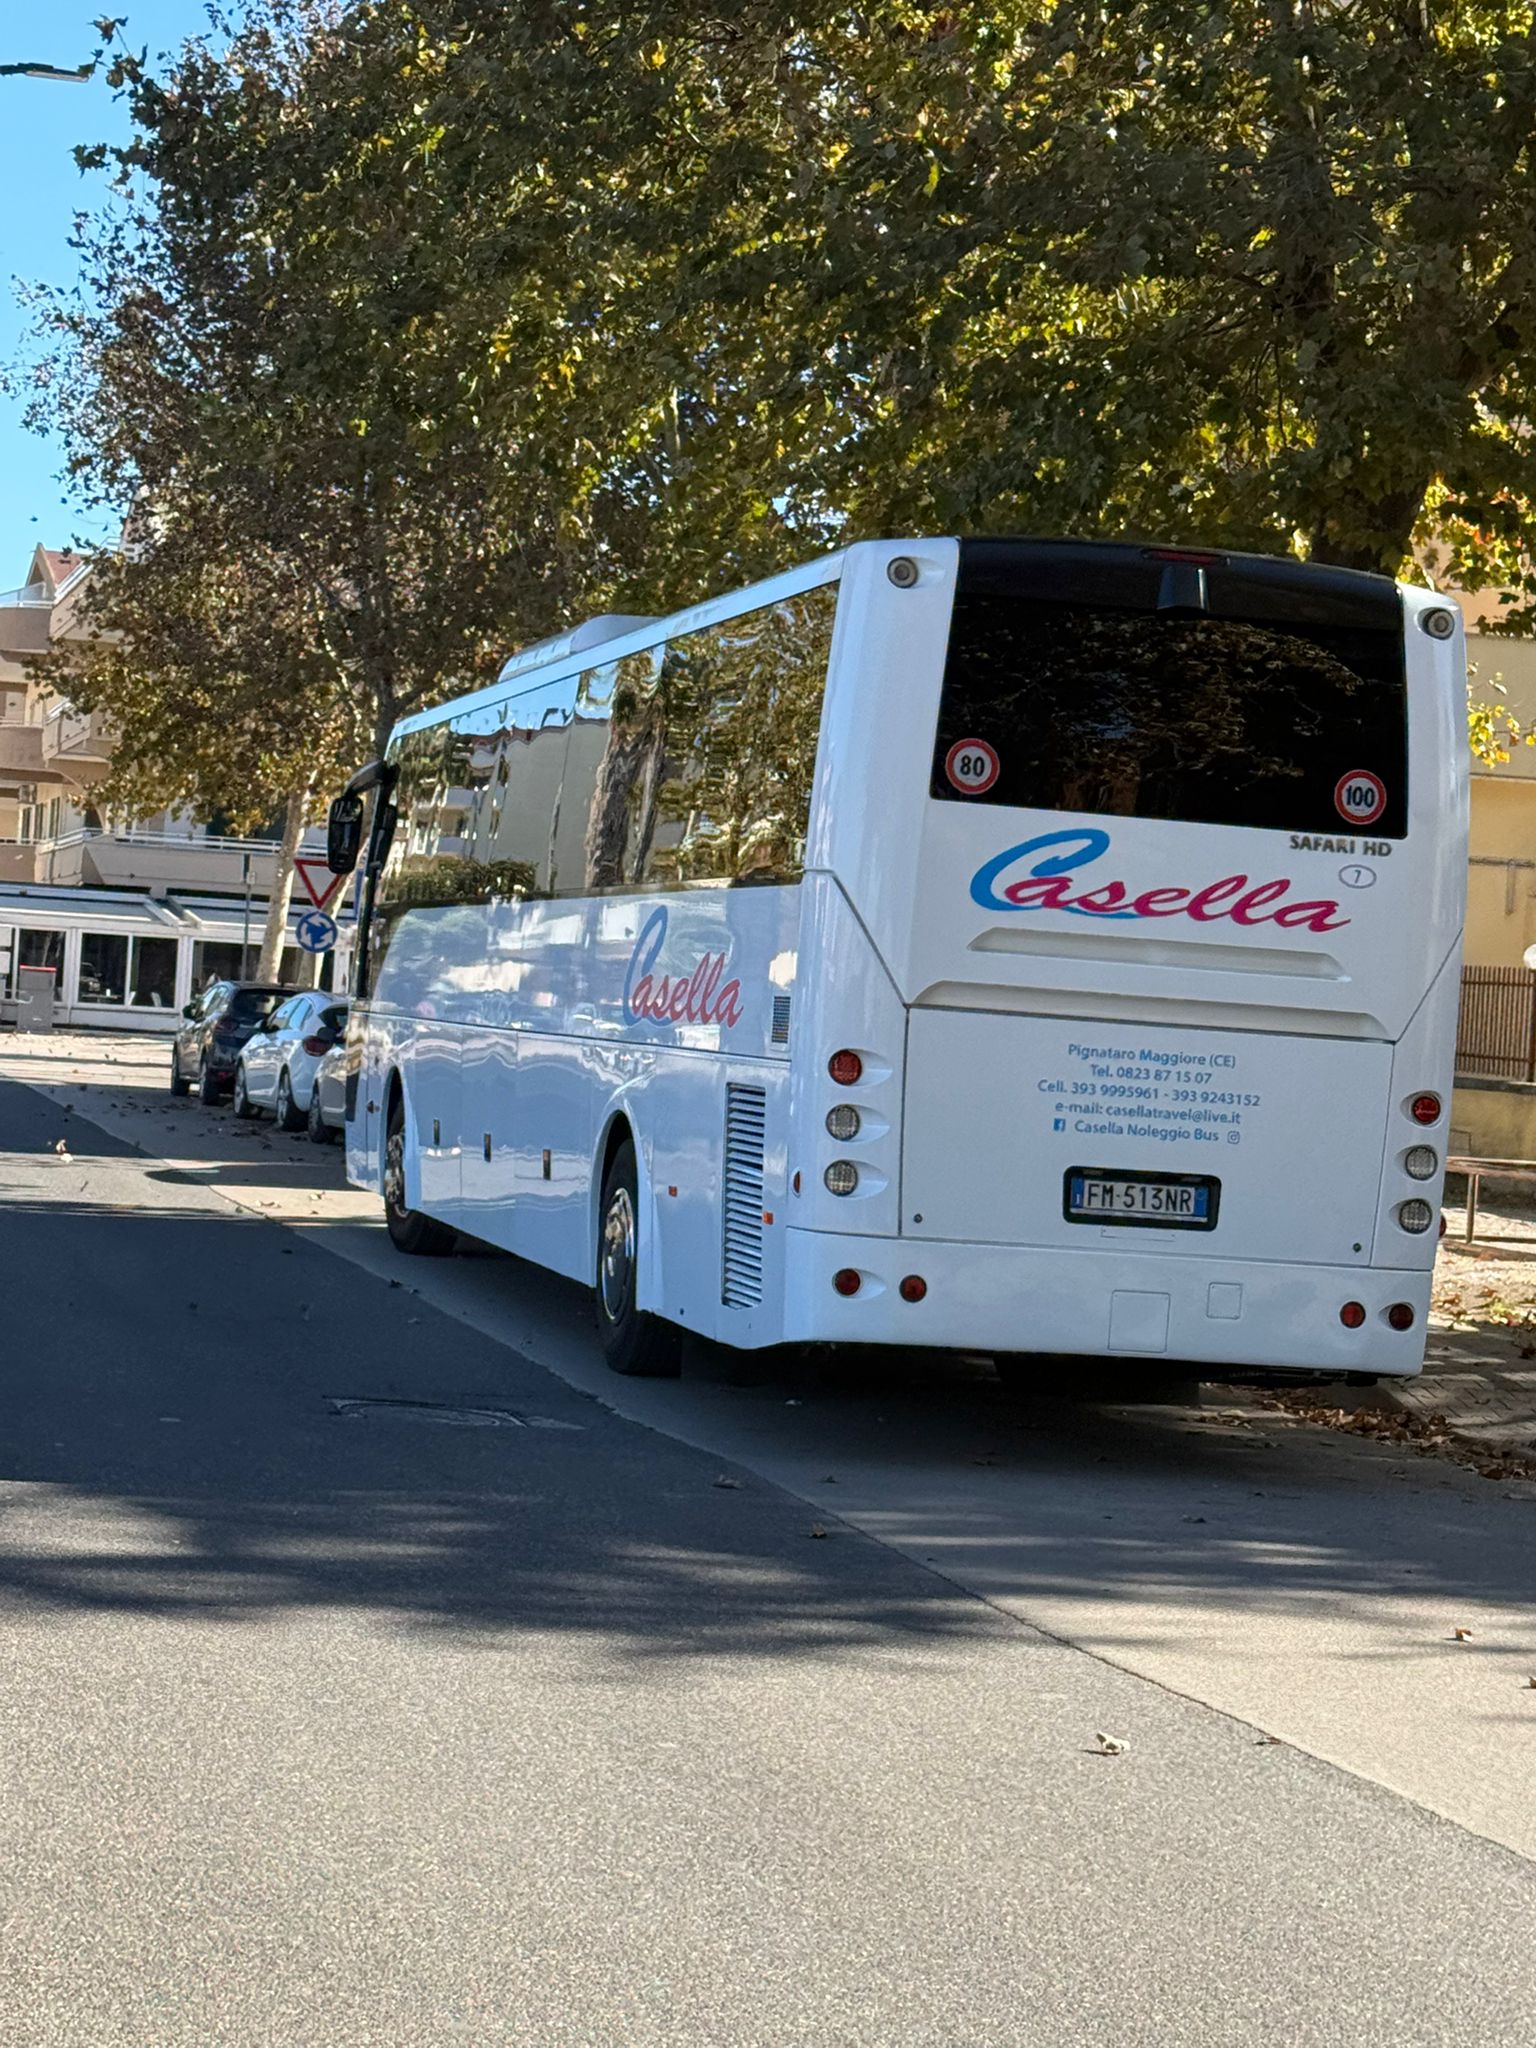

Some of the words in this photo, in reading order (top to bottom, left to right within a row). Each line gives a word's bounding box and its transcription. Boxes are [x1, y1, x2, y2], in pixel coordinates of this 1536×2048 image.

[960, 754, 985, 778] 80
[1346, 785, 1375, 808] 100
[1289, 834, 1356, 854] SAFARI
[1362, 841, 1392, 857] HD
[969, 828, 1351, 932] Casella
[1354, 869, 1362, 884] 7
[623, 904, 744, 1028] Casella
[1068, 1043, 1136, 1060] Pignataro
[1139, 1049, 1206, 1066] Maggiore
[1209, 1053, 1236, 1069] (CE)
[1090, 1063, 1113, 1077] Tel.
[1116, 1066, 1150, 1080] 0823
[1153, 1069, 1171, 1082] 87
[1176, 1070, 1191, 1083] 15
[1194, 1072, 1212, 1085] 07
[1037, 1079, 1068, 1093] Cell.
[1071, 1082, 1096, 1096] 393
[1100, 1084, 1159, 1100] 9995961
[1171, 1089, 1197, 1102] 393
[1200, 1091, 1260, 1107] 9243152
[1055, 1102, 1103, 1114] e-mail:
[1105, 1105, 1241, 1124] casellatravel@live.it
[1074, 1120, 1124, 1135] Casella
[1126, 1123, 1191, 1142] Noleggio
[1194, 1128, 1219, 1141] Bus
